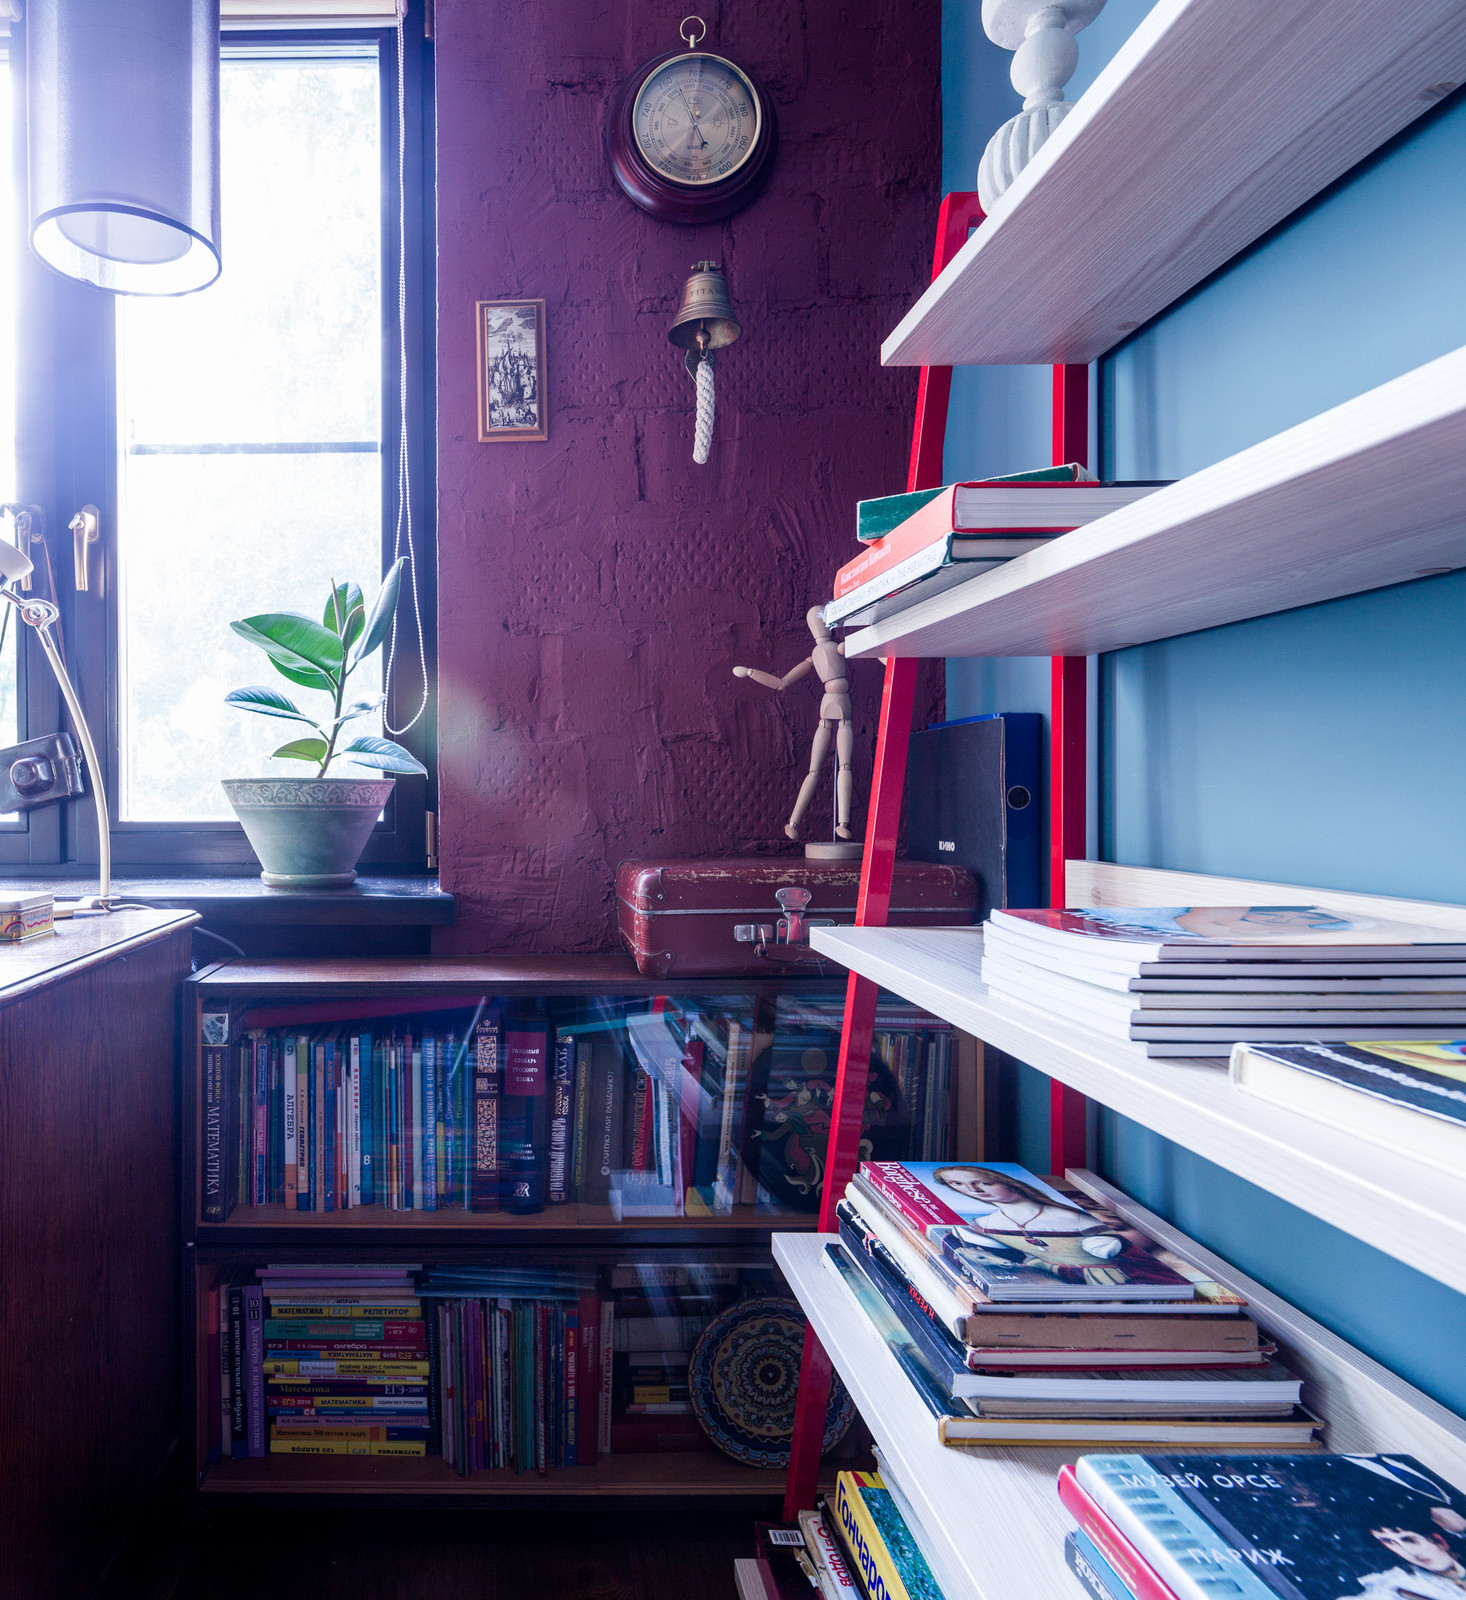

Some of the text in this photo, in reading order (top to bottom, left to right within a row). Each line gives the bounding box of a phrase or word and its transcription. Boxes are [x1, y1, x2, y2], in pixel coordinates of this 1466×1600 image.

[659, 78, 672, 89] 750
[718, 76, 733, 90] 770
[641, 102, 652, 118] 740
[739, 102, 748, 117] 780
[641, 133, 651, 149] 730
[739, 135, 748, 151] 790
[657, 161, 672, 174] 720
[718, 161, 733, 174] 800
[938, 840, 955, 852] КИНО
[558, 1048, 568, 1082] ДАЛЬ
[286, 1093, 294, 1139] АЛГЕБРА
[632, 1093, 647, 1167] ОРФОГРАФИЧЕСКИЙ
[207, 1105, 220, 1195] МАТЕМАТИКА
[549, 1118, 566, 1191] ТОЛКОВЫЙ СЛОВАРЬ
[602, 1135, 610, 1165] СЛИТНО
[363, 1155, 370, 1166] 8
[873, 1161, 931, 1204] Borghese
[248, 1298, 259, 1309] 10
[248, 1309, 258, 1320] 11
[233, 1320, 241, 1356] анализа
[309, 1324, 353, 1335] МАТЕМАТИКА
[250, 1325, 262, 1363] Алгебра
[233, 1357, 241, 1387] начала
[604, 1347, 612, 1395] АЛГЕБРА
[233, 1396, 243, 1432] Алгебра
[1118, 1472, 1282, 1489] МУЗЕЙ ОРСЕ
[1186, 1548, 1294, 1565] ПАРИЖ
